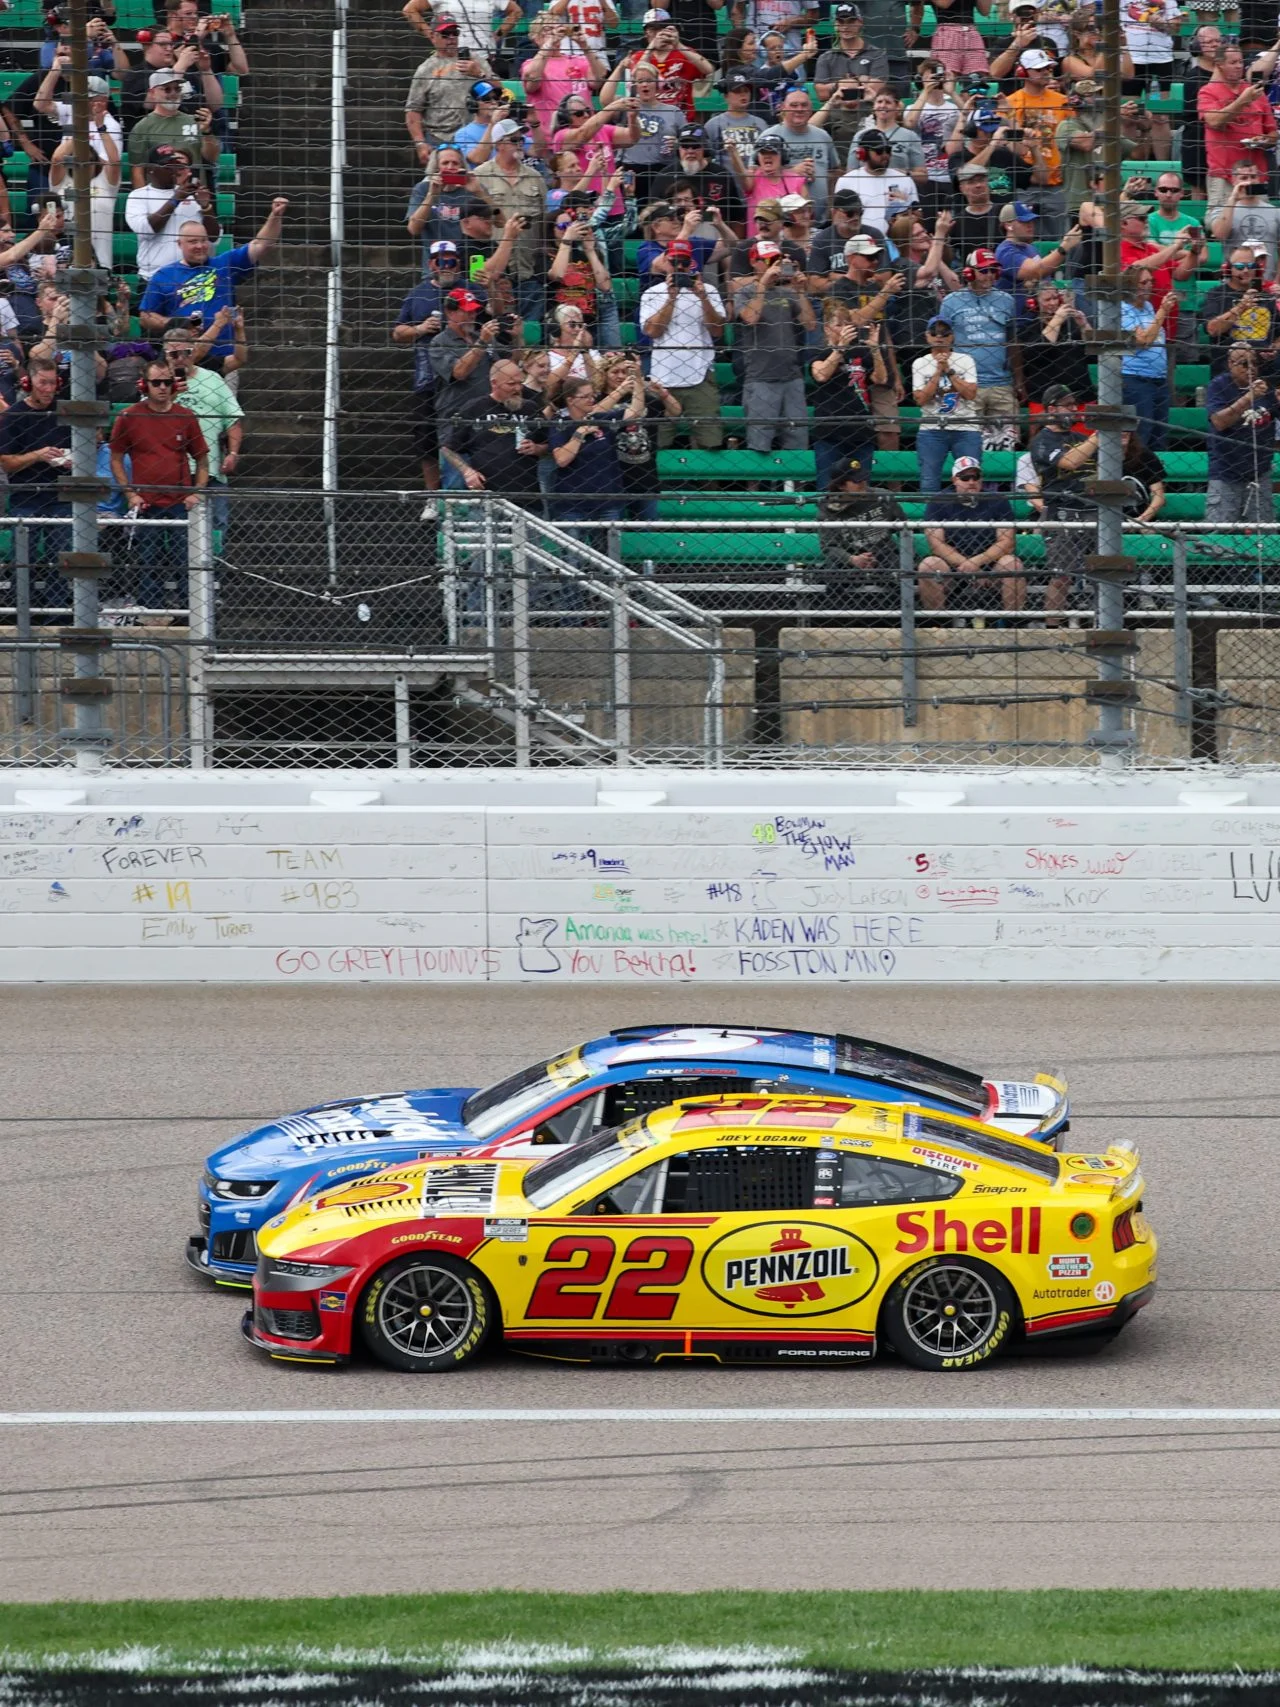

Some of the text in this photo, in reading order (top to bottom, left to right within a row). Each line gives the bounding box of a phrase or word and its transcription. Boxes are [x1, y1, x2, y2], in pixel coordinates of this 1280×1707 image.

[752, 823, 775, 843] 48
[101, 846, 207, 874] FOREVER
[266, 847, 343, 870] TEAM
[706, 883, 742, 902] #48
[141, 917, 198, 941] Emily
[637, 925, 663, 942] was
[734, 915, 925, 947] KADEN WAS HERE
[275, 949, 320, 975] GO
[739, 949, 837, 976] FOSSTON
[716, 1134, 807, 1142] JOEY LOGANO
[911, 1145, 980, 1172] DISCOUNT
[928, 1158, 959, 1172] TIRE
[972, 1184, 1027, 1196] Snap-on
[391, 1230, 463, 1245] GOODYEAR
[895, 1206, 1042, 1254] Shell
[524, 1235, 695, 1321] 22
[726, 1248, 853, 1289] PENNZOIL
[1032, 1287, 1092, 1300] Autotrader
